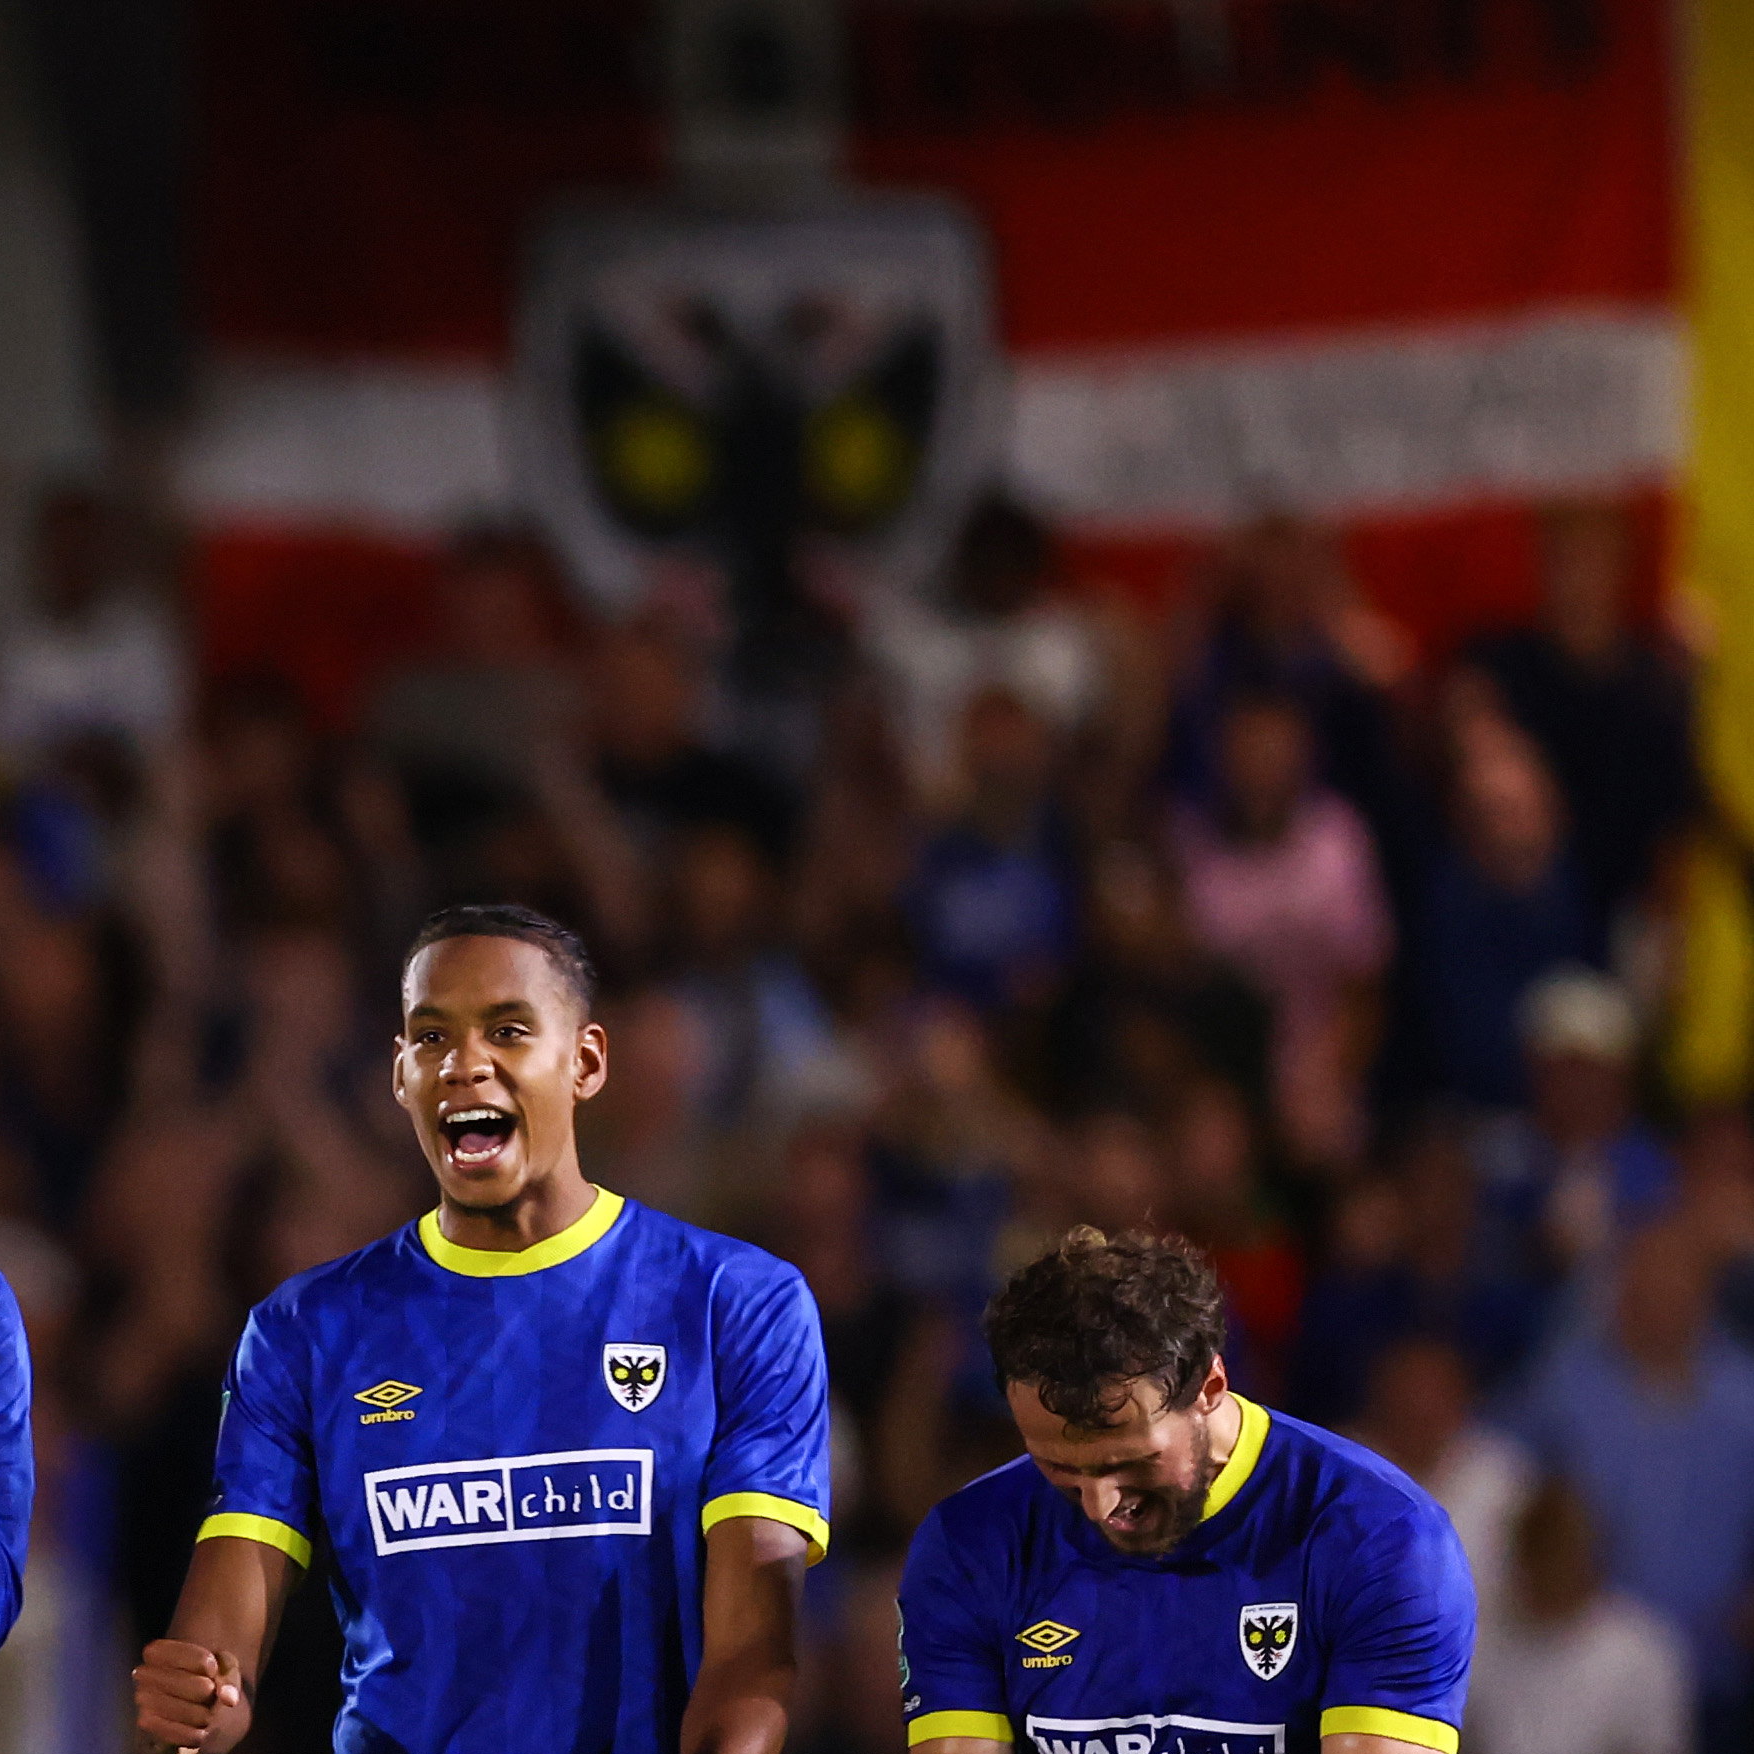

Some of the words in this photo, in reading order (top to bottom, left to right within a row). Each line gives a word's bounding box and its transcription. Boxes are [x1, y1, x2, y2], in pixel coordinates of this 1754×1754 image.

[359, 1408, 416, 1426] umbro
[375, 1480, 506, 1532] WAR
[520, 1473, 635, 1518] child
[1021, 1653, 1074, 1669] umbro
